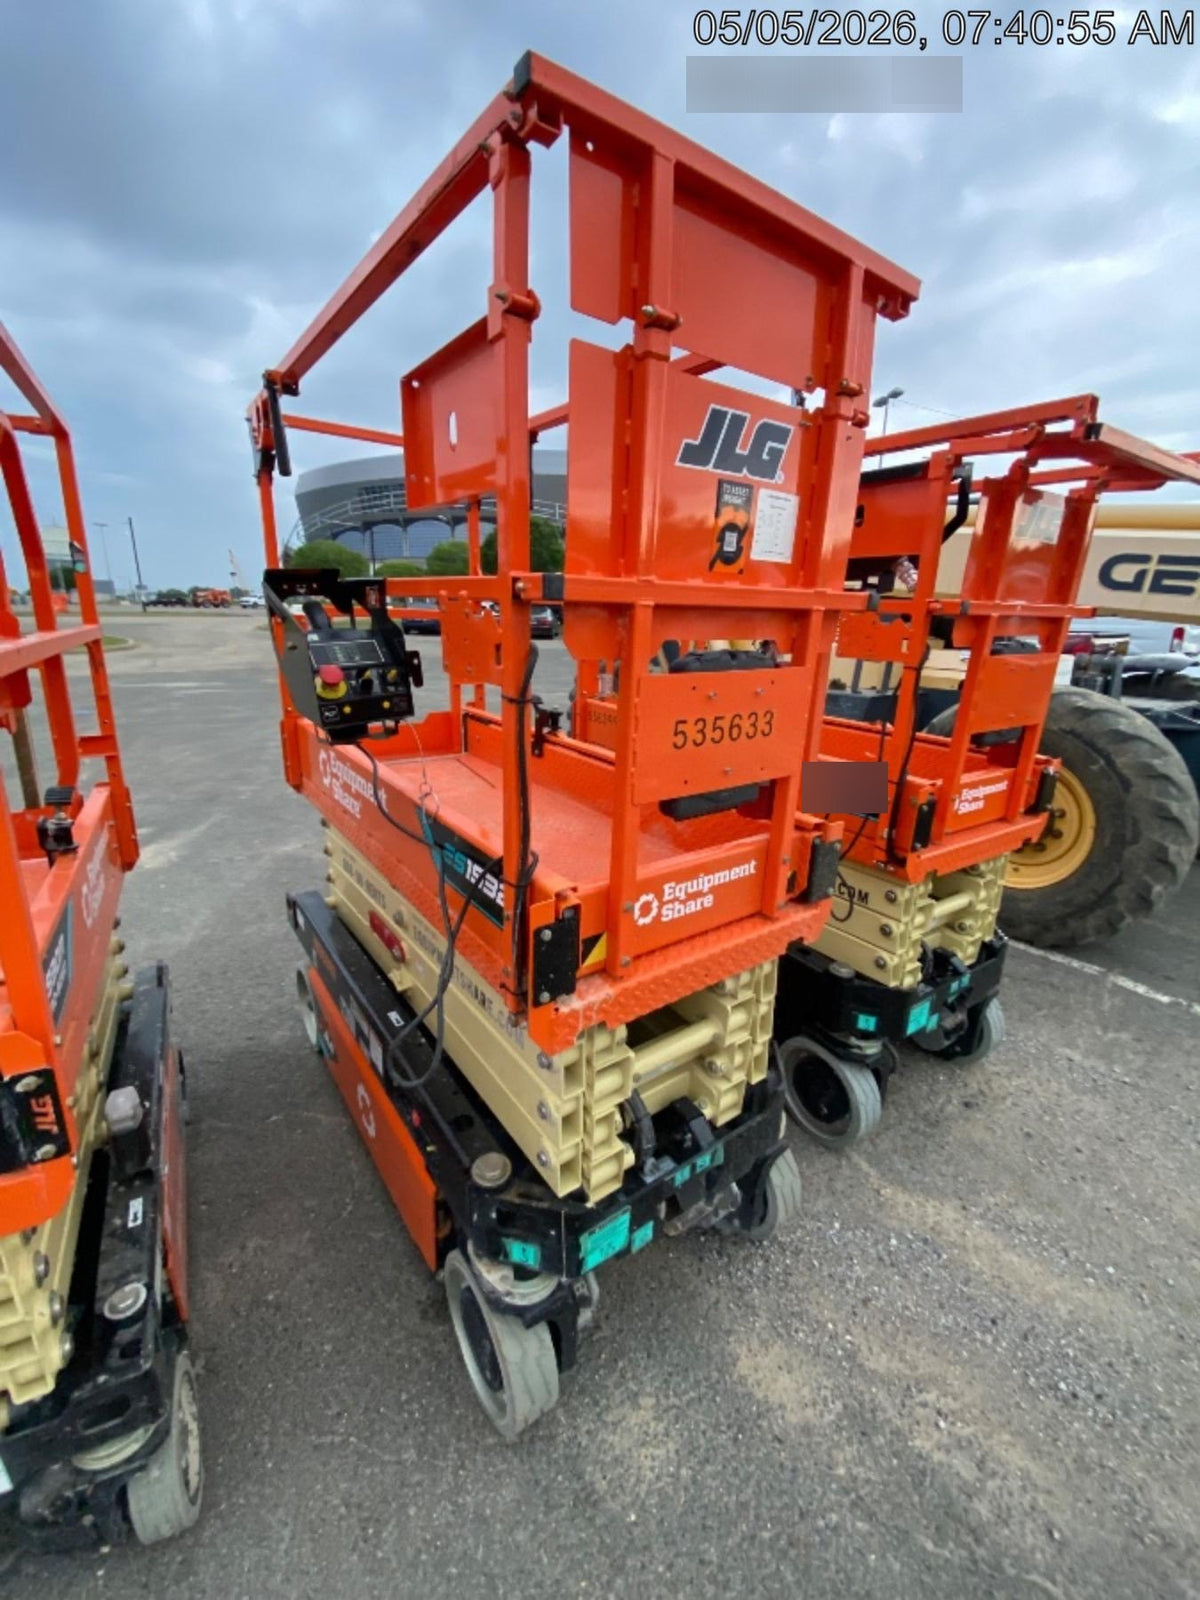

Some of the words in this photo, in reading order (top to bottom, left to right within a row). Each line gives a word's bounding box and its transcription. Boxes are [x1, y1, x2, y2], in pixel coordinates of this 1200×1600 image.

[675, 403, 794, 483] JLG
[673, 709, 775, 751] 535633
[957, 799, 986, 815] Share
[961, 780, 1009, 801] Equipment
[662, 859, 757, 904] Equipment
[660, 893, 714, 923] Share
[30, 1093, 60, 1135] JLG
